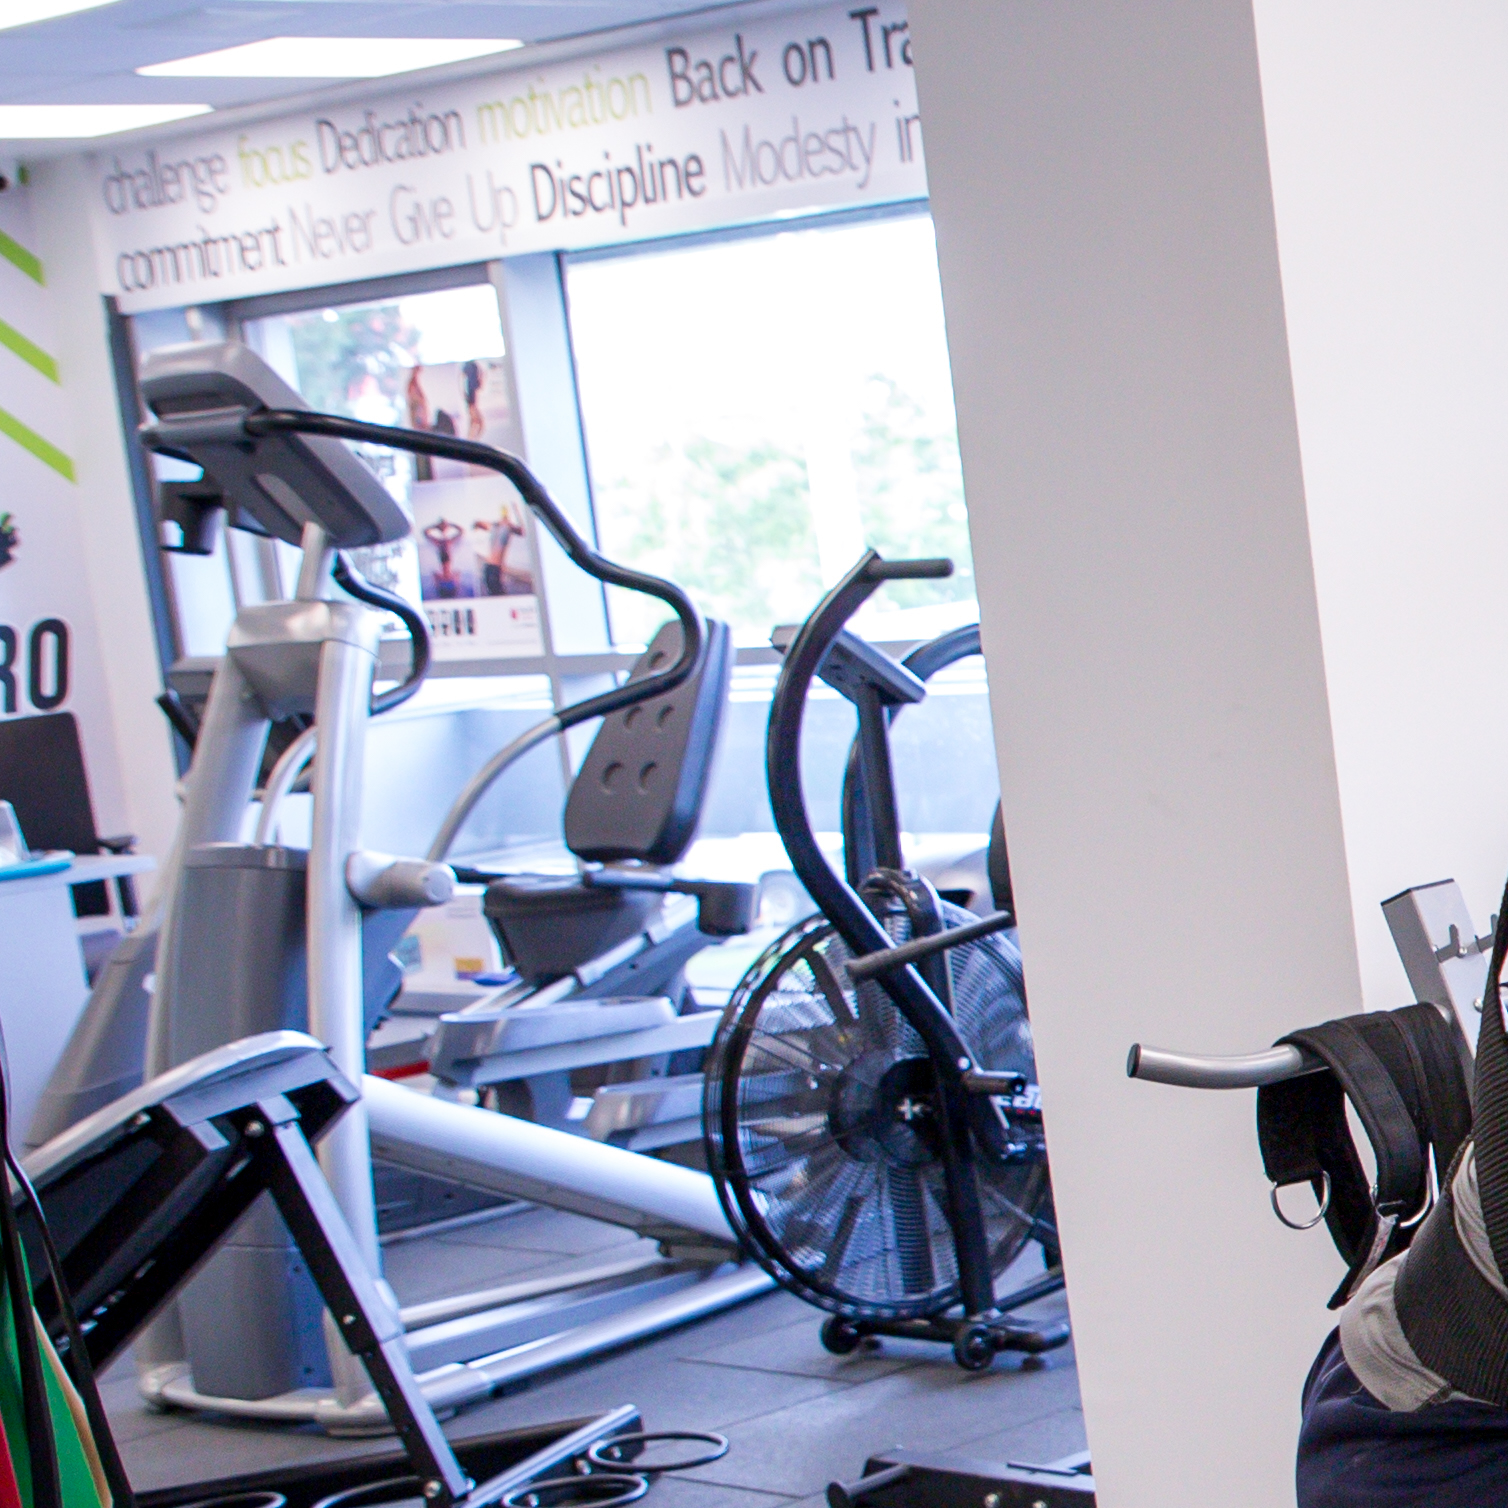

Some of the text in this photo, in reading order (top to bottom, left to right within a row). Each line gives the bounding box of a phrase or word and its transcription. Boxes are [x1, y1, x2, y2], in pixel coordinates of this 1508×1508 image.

[103, 149, 230, 214] challenge
[237, 133, 313, 189] focus
[314, 102, 468, 174] Dedication
[476, 64, 654, 146] motivation
[665, 33, 765, 108] Back
[782, 35, 835, 87] on
[116, 215, 289, 293] commitment
[288, 203, 377, 261] Never
[389, 183, 455, 246] Give
[465, 169, 519, 247] Up
[530, 141, 707, 227] Discipline
[718, 115, 878, 191] Modesty
